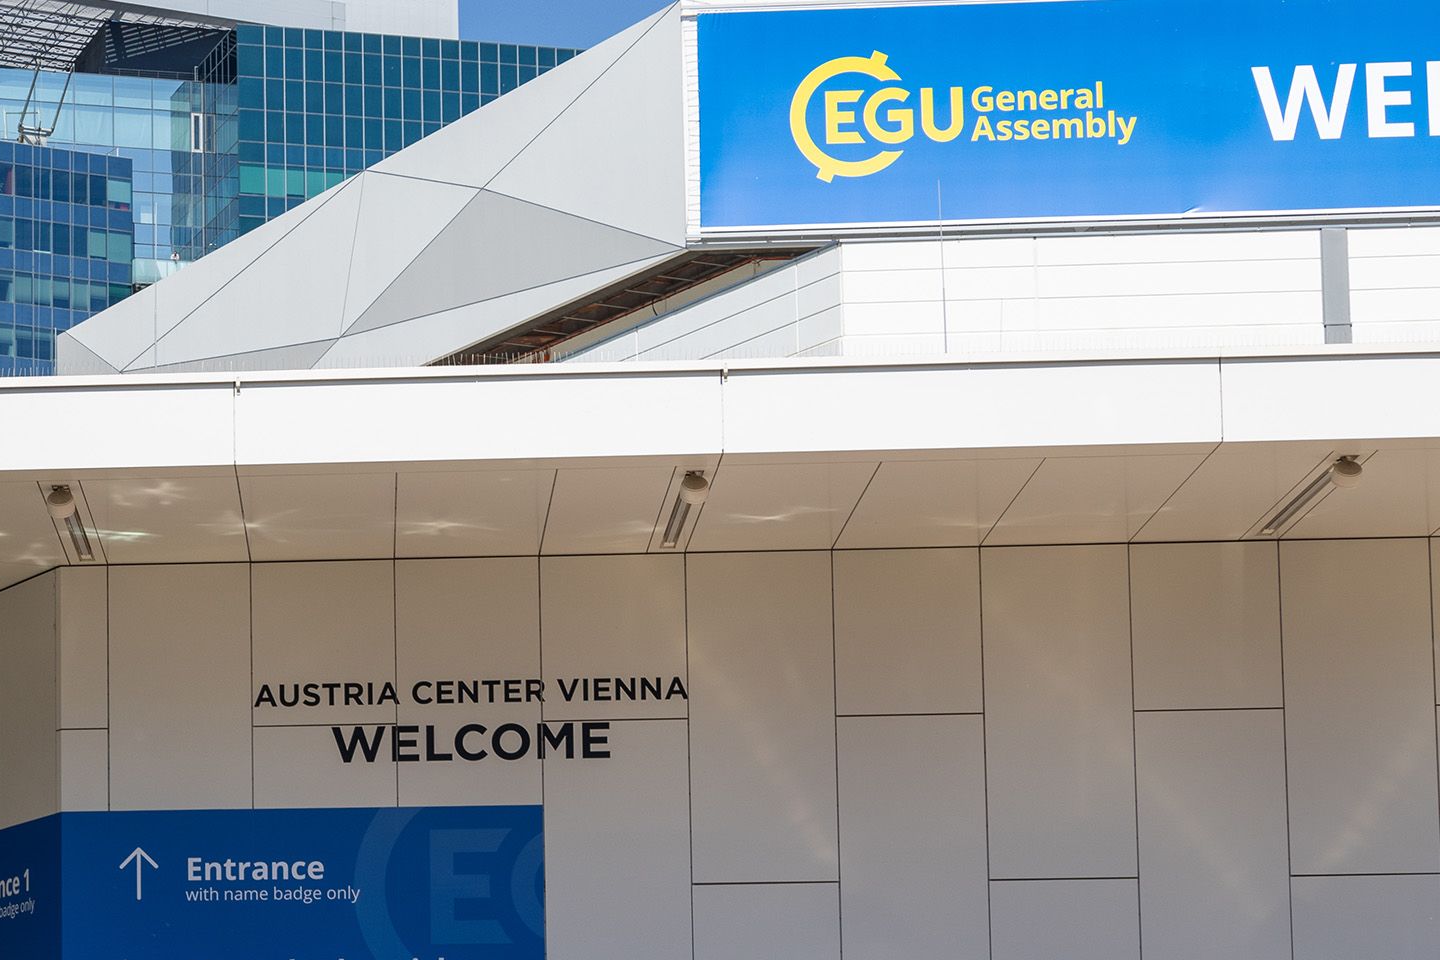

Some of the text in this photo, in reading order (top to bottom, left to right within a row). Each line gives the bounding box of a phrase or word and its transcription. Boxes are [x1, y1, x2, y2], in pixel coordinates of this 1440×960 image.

[825, 81, 1104, 144] EGU General
[971, 110, 1137, 145] Assembly
[254, 676, 688, 708] AUSTRIA CENTER VIENNA
[331, 722, 611, 763] WELCOME
[23, 868, 30, 892] 1
[186, 857, 325, 881] Entrance
[0, 902, 19, 919] badge
[20, 897, 35, 914] only
[186, 886, 360, 904] with name badge only
